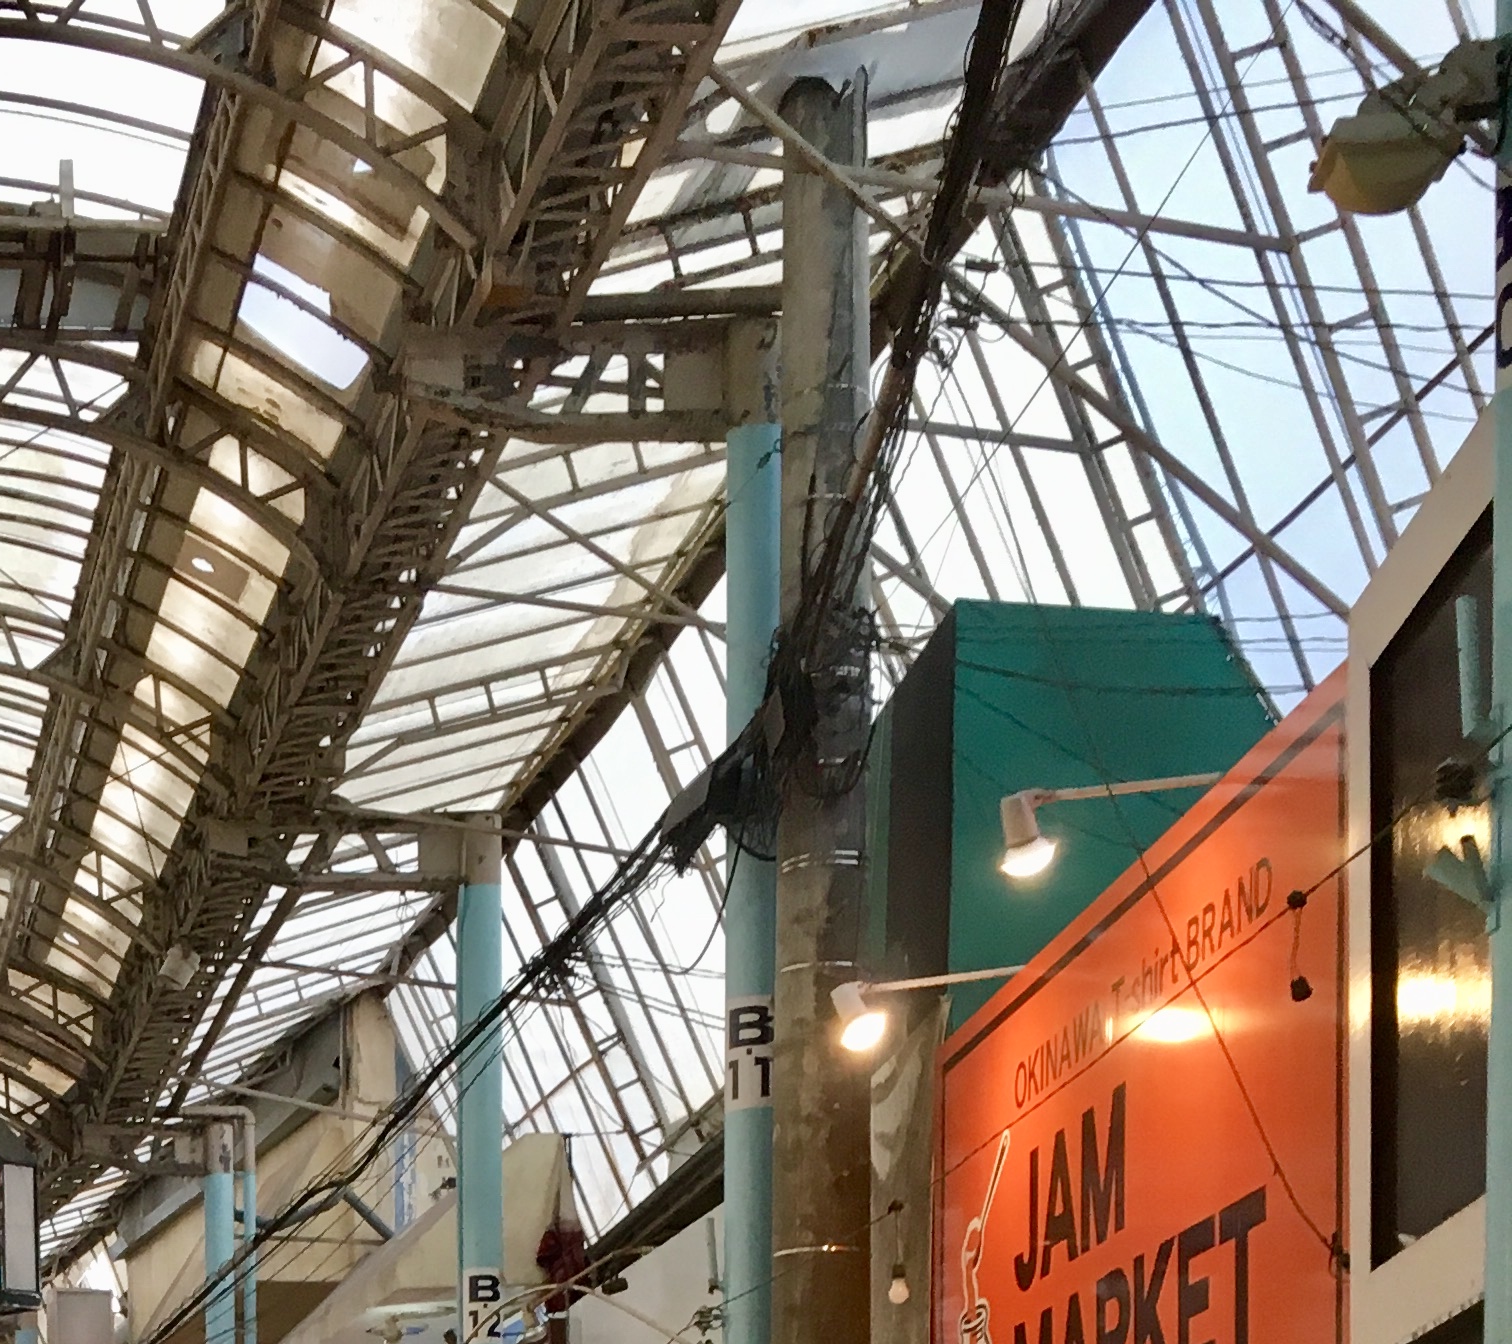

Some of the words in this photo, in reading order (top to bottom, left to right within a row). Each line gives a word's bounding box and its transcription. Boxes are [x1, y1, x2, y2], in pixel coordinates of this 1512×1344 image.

[728, 1005, 774, 1047] B
[1014, 1000, 1105, 1109] OKINAWA
[1187, 857, 1273, 972] BRAND
[1013, 1081, 1127, 1293] JAM
[469, 1275, 501, 1303] B
